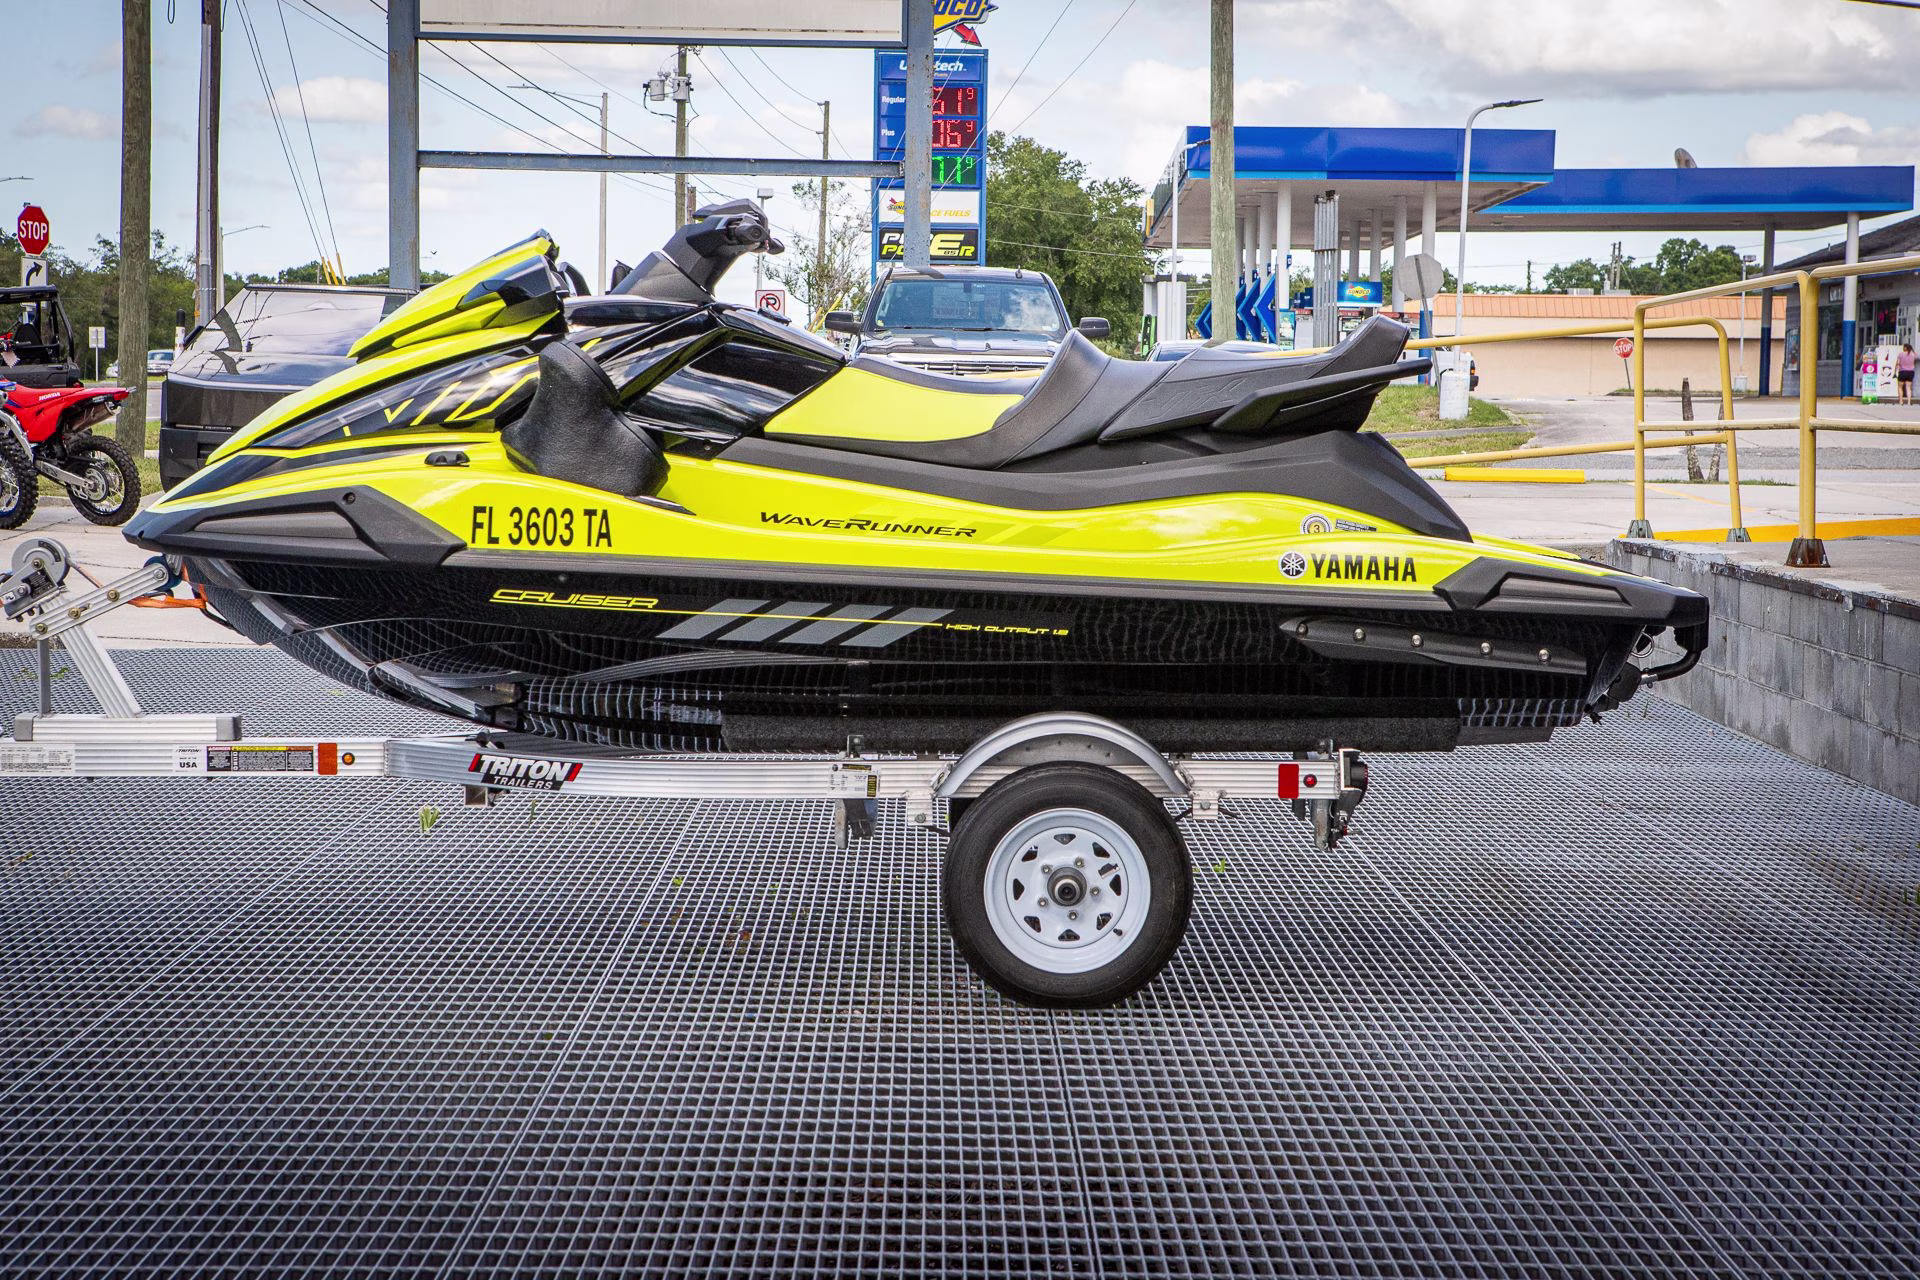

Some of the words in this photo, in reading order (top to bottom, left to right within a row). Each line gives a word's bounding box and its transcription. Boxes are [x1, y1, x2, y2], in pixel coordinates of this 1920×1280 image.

[934, 0, 979, 15] OCO
[881, 95, 906, 105] Regular
[880, 129, 895, 137] Plus
[944, 209, 972, 217] FUELS
[19, 220, 48, 241] STOP
[1615, 343, 1633, 354] STOP
[39, 392, 61, 401] HONDA
[471, 505, 500, 545] FL
[508, 506, 574, 546] 3603
[583, 508, 613, 548] TA
[1311, 553, 1417, 582] YAMAHA
[492, 589, 659, 609] CRUISER
[945, 623, 980, 631] HIGH
[984, 625, 1050, 635] OUTPUT
[179, 761, 198, 769] USA
[480, 754, 571, 782] TRITON
[493, 775, 553, 790] TRAILERS
